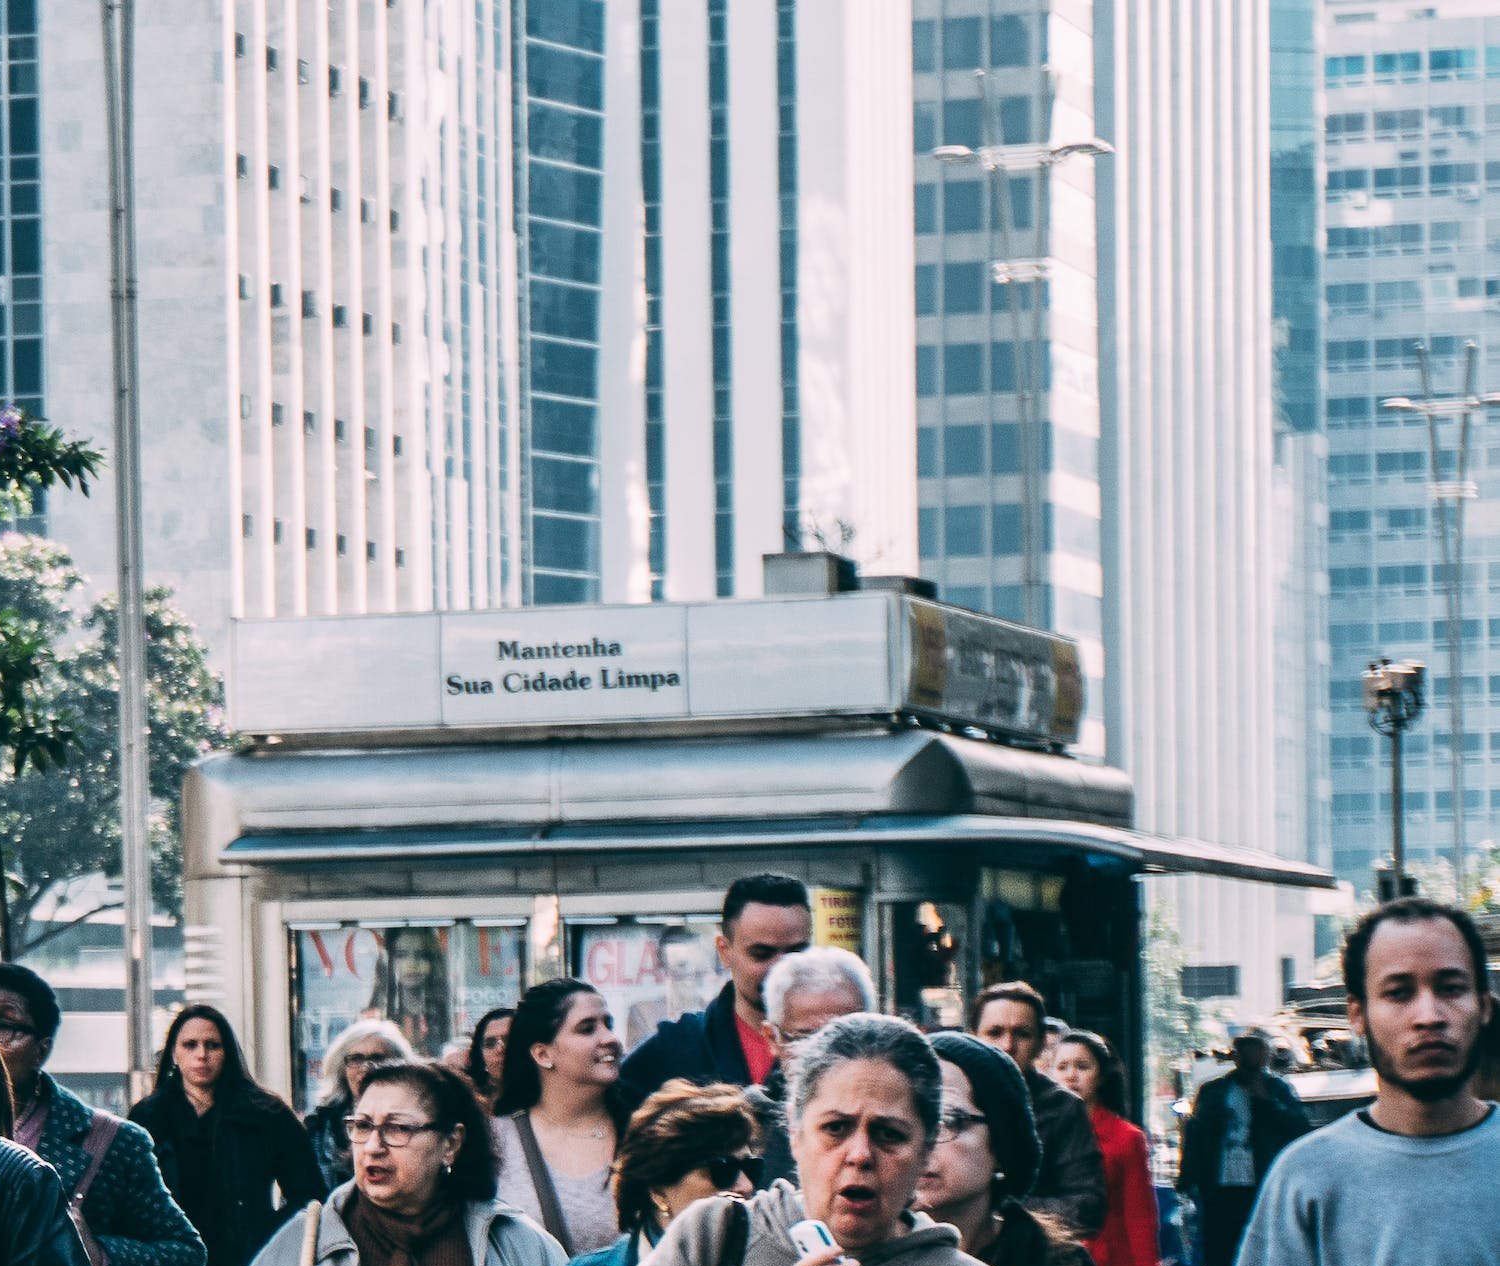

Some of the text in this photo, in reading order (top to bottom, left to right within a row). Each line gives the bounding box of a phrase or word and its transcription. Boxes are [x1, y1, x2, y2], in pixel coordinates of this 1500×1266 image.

[498, 638, 623, 661] Mantenha
[446, 668, 681, 695] Sua Cidade Limpa
